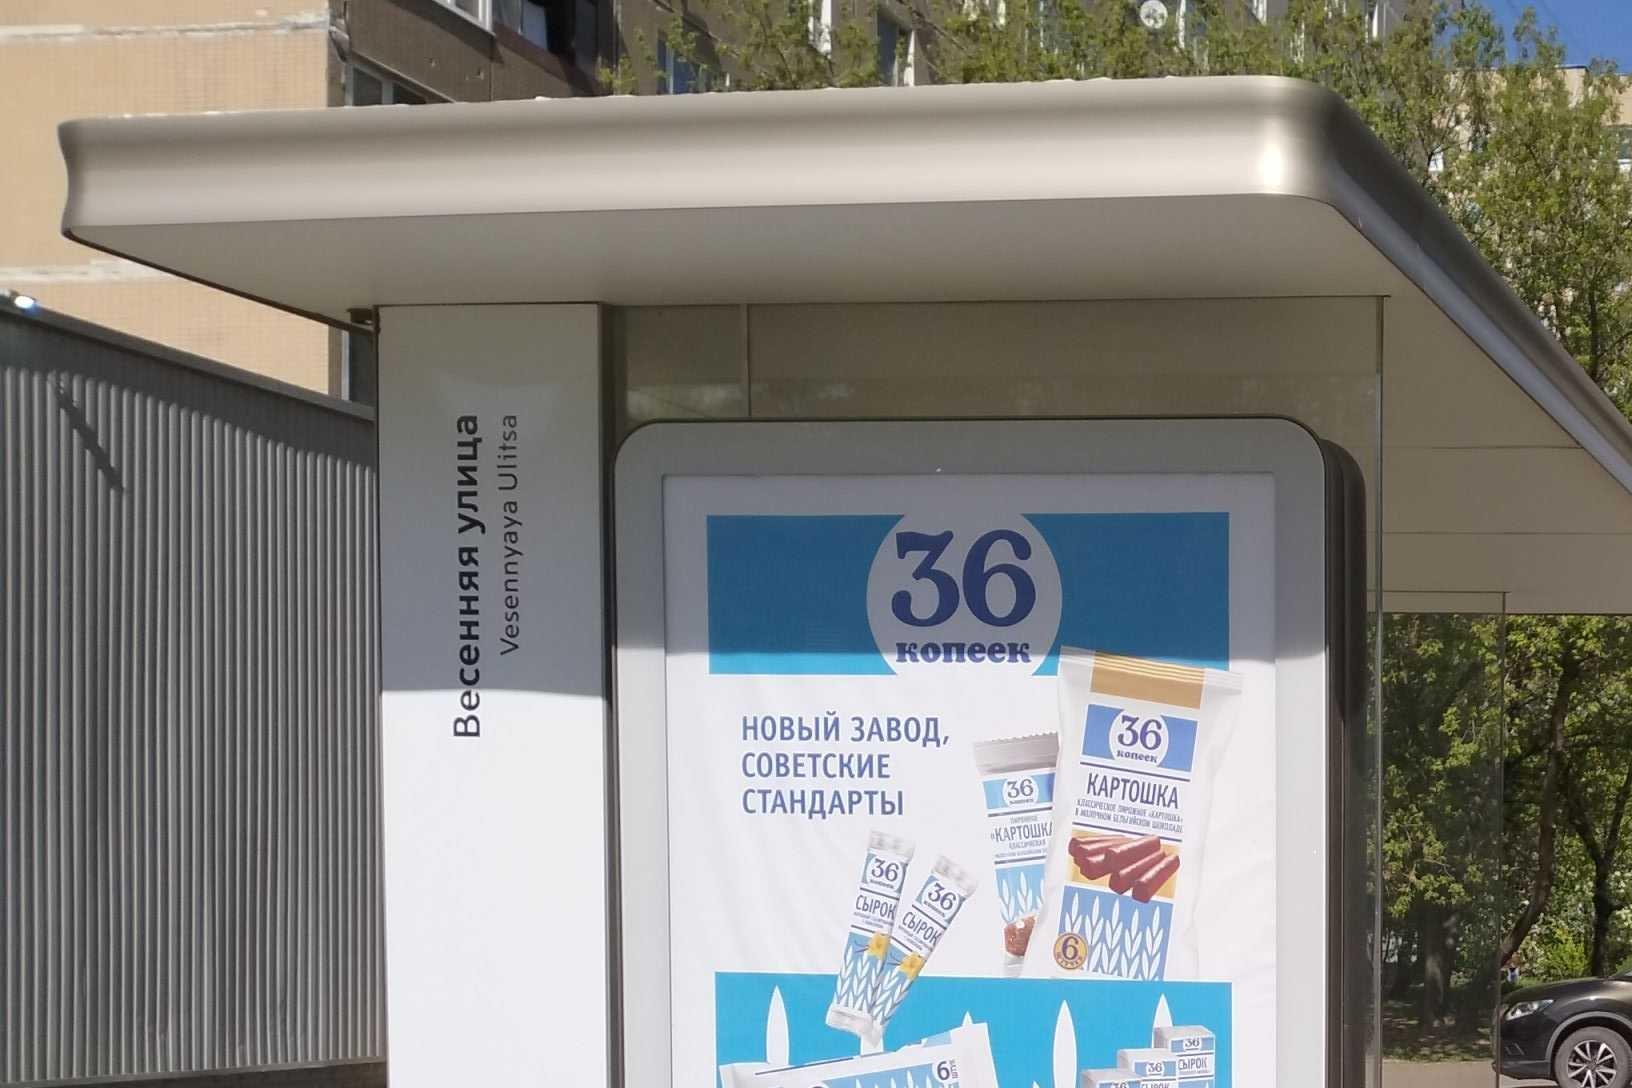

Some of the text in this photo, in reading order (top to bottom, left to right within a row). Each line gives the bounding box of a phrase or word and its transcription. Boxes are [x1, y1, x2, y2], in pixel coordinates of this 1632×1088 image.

[497, 415, 523, 656] Vesennyaya Ulitsa
[453, 415, 486, 737] Весенняя улица
[891, 529, 1036, 627] 36
[896, 642, 1032, 663] копеек
[742, 710, 950, 747] НОВЫЙ ЗАВОД,
[1117, 714, 1162, 750] 36
[741, 753, 891, 778] СОВЕТСКИЕ
[1117, 749, 1158, 763] копеек
[1007, 778, 1034, 798] 36
[1087, 772, 1179, 809] КАРТОШКА
[742, 788, 903, 820] СТАНДАРТЫ
[872, 858, 899, 882] 36
[856, 895, 897, 920] СЫРОК
[928, 883, 957, 910] 36
[902, 911, 942, 946] СЫРОК
[1062, 936, 1079, 960] 6
[937, 1061, 950, 1080] 6
[1148, 1063, 1163, 1073] 36
[1178, 1057, 1207, 1070] СЫРОК
